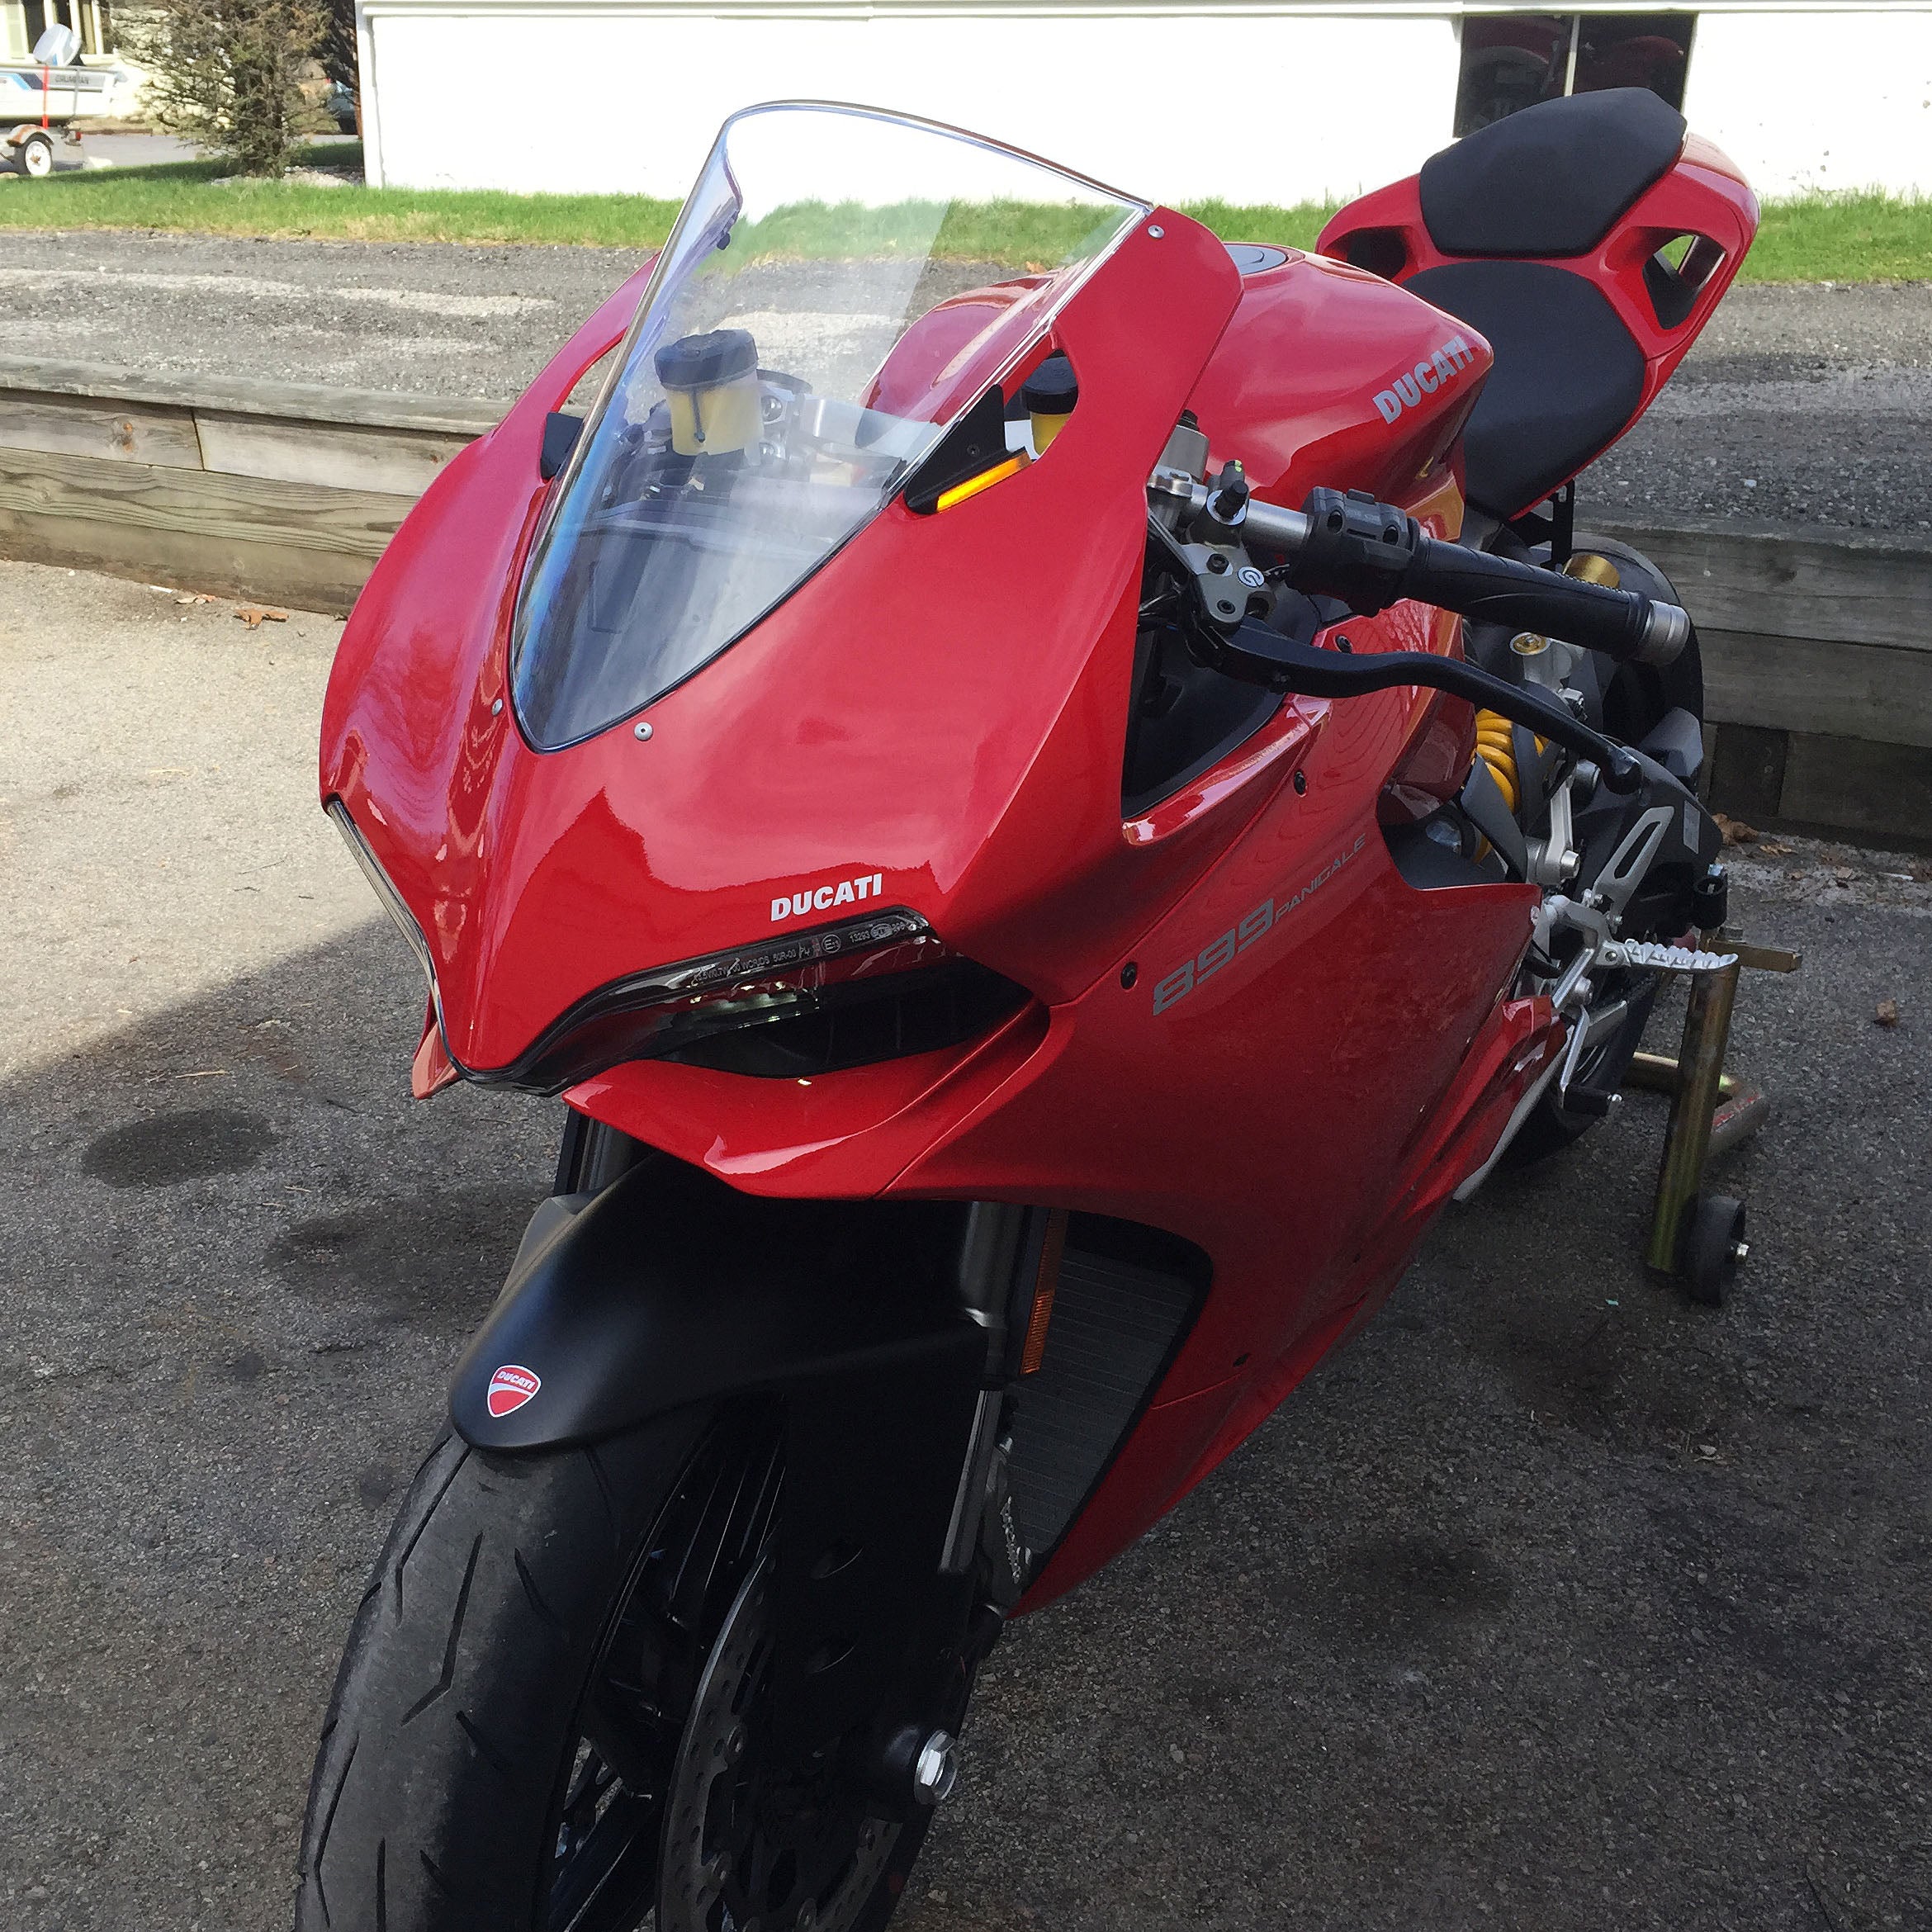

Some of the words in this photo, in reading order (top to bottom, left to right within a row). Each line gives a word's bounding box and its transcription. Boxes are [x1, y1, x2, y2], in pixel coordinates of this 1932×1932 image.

[1372, 335, 1475, 424] DUCATI
[770, 873, 883, 922] DUCATI
[1153, 897, 1274, 1016] 899
[1274, 832, 1366, 924] PANIGALE
[497, 1371, 536, 1390] DUCATI
